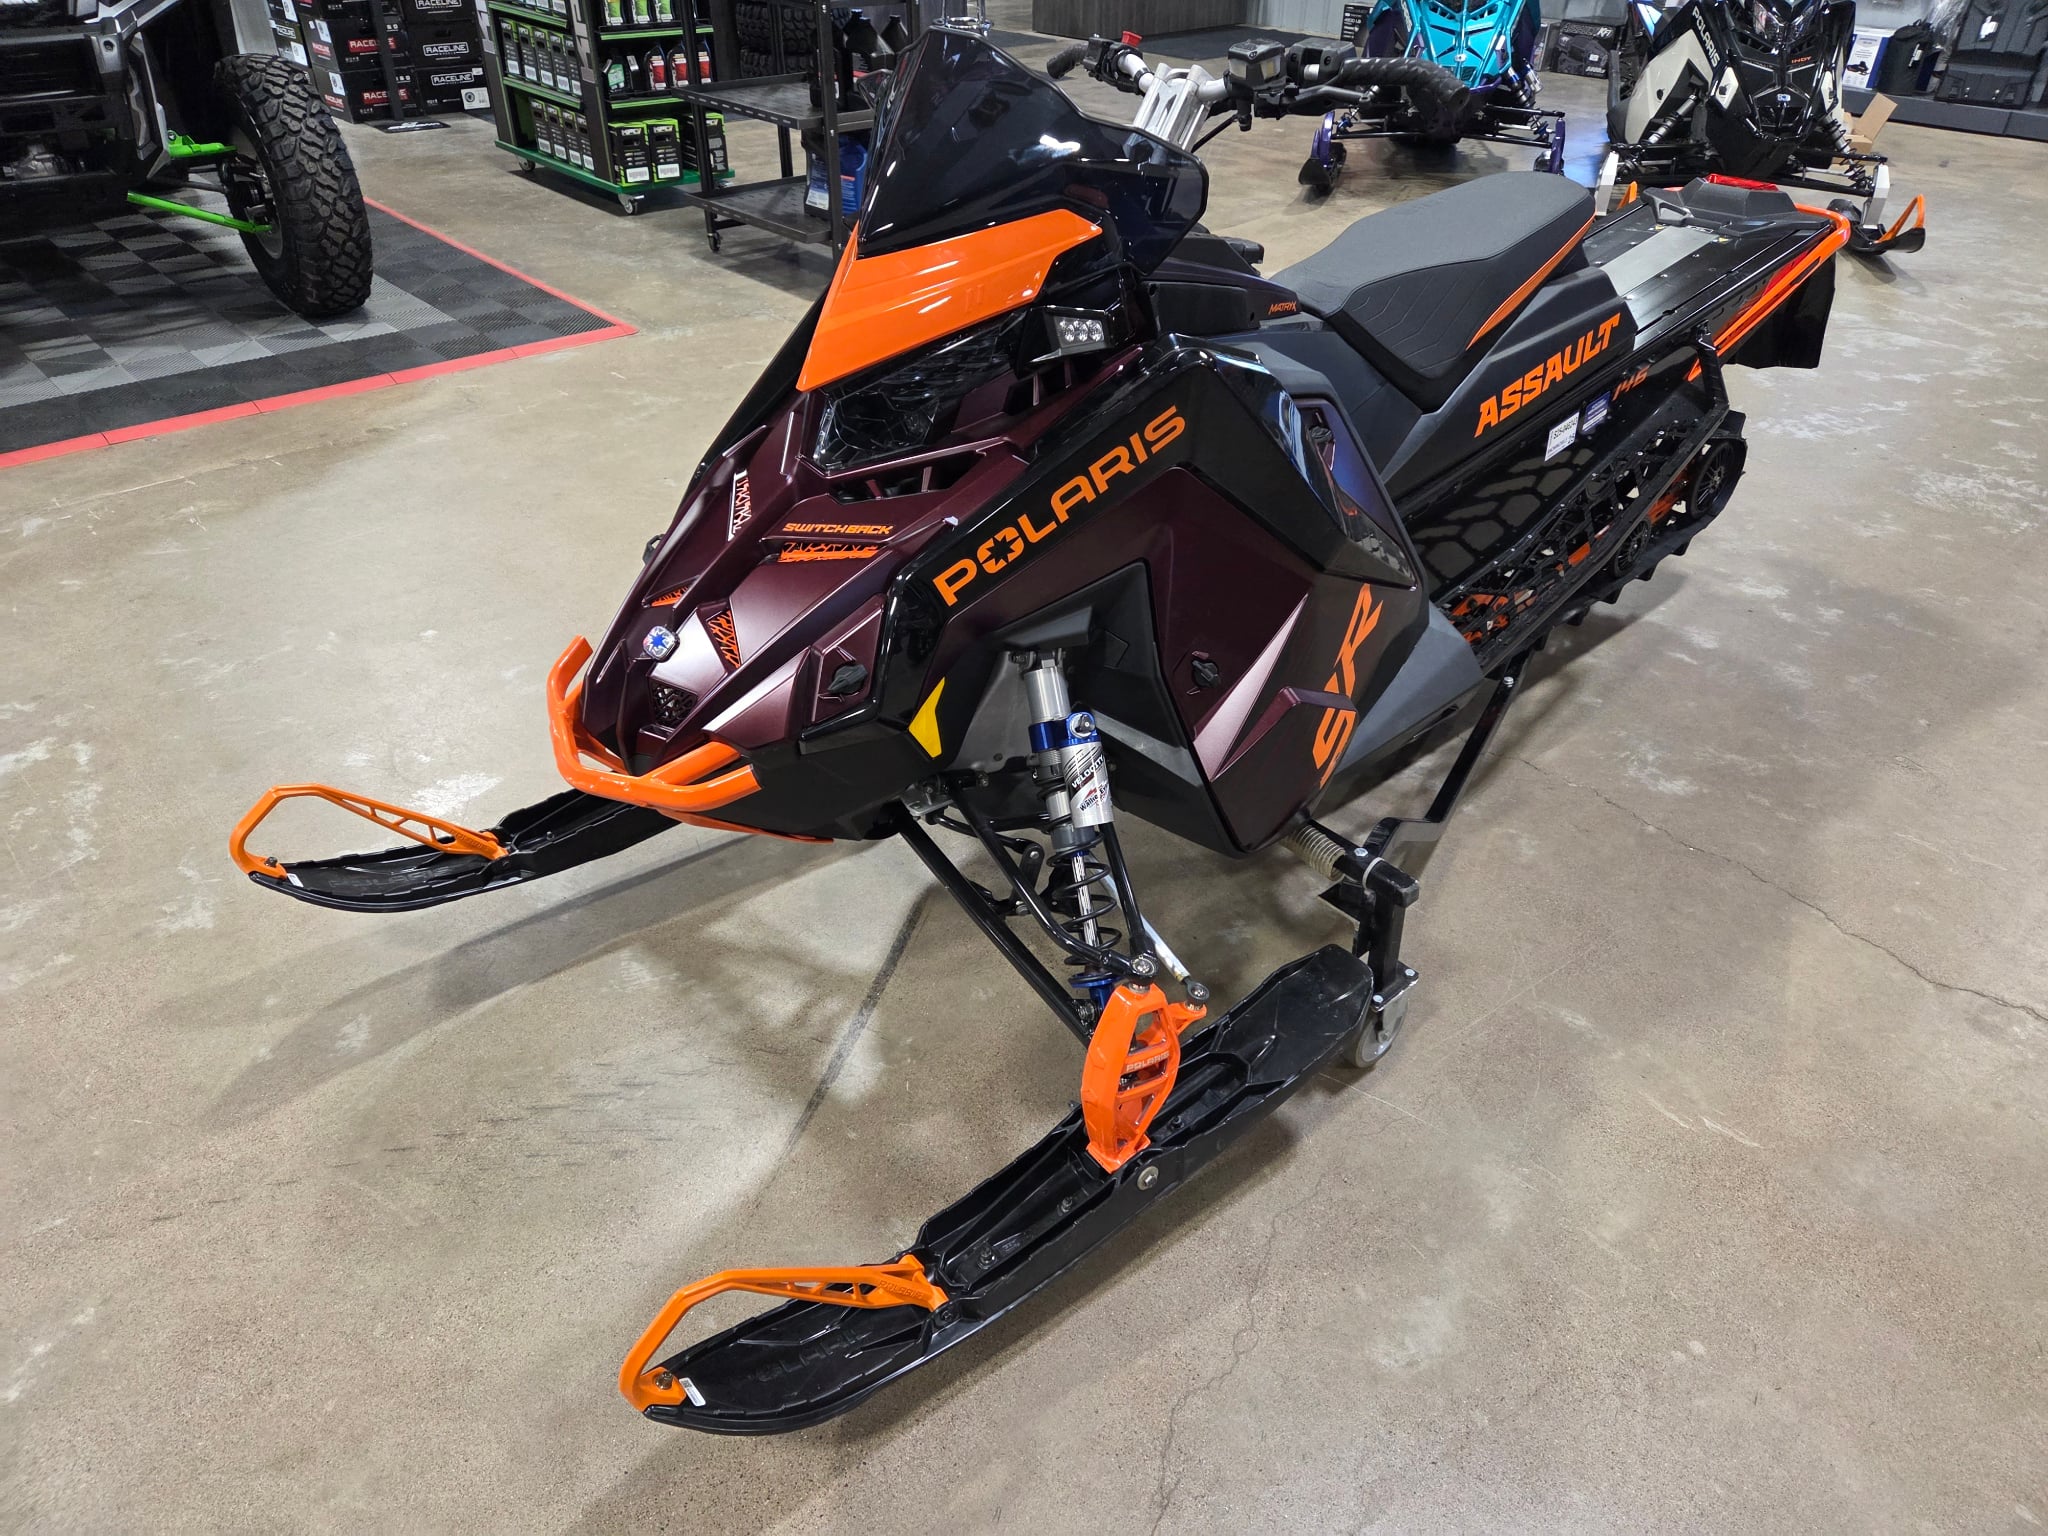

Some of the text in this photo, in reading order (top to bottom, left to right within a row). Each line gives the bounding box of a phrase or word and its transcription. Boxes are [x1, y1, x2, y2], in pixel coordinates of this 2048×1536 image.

[1692, 6, 1721, 68] POLARIS
[425, 43, 466, 54] RACELINE
[1791, 56, 1812, 64] INDY
[433, 73, 472, 83] RACELINE
[1267, 301, 1297, 315] MATRYX
[1474, 313, 1621, 438] ASSAULT
[1611, 365, 1649, 401] 146
[932, 405, 1186, 607] POLARIS
[783, 522, 894, 535] SWITCHBACK
[1071, 753, 1105, 788] VELOCITY
[1126, 1050, 1170, 1072] POLARIS
